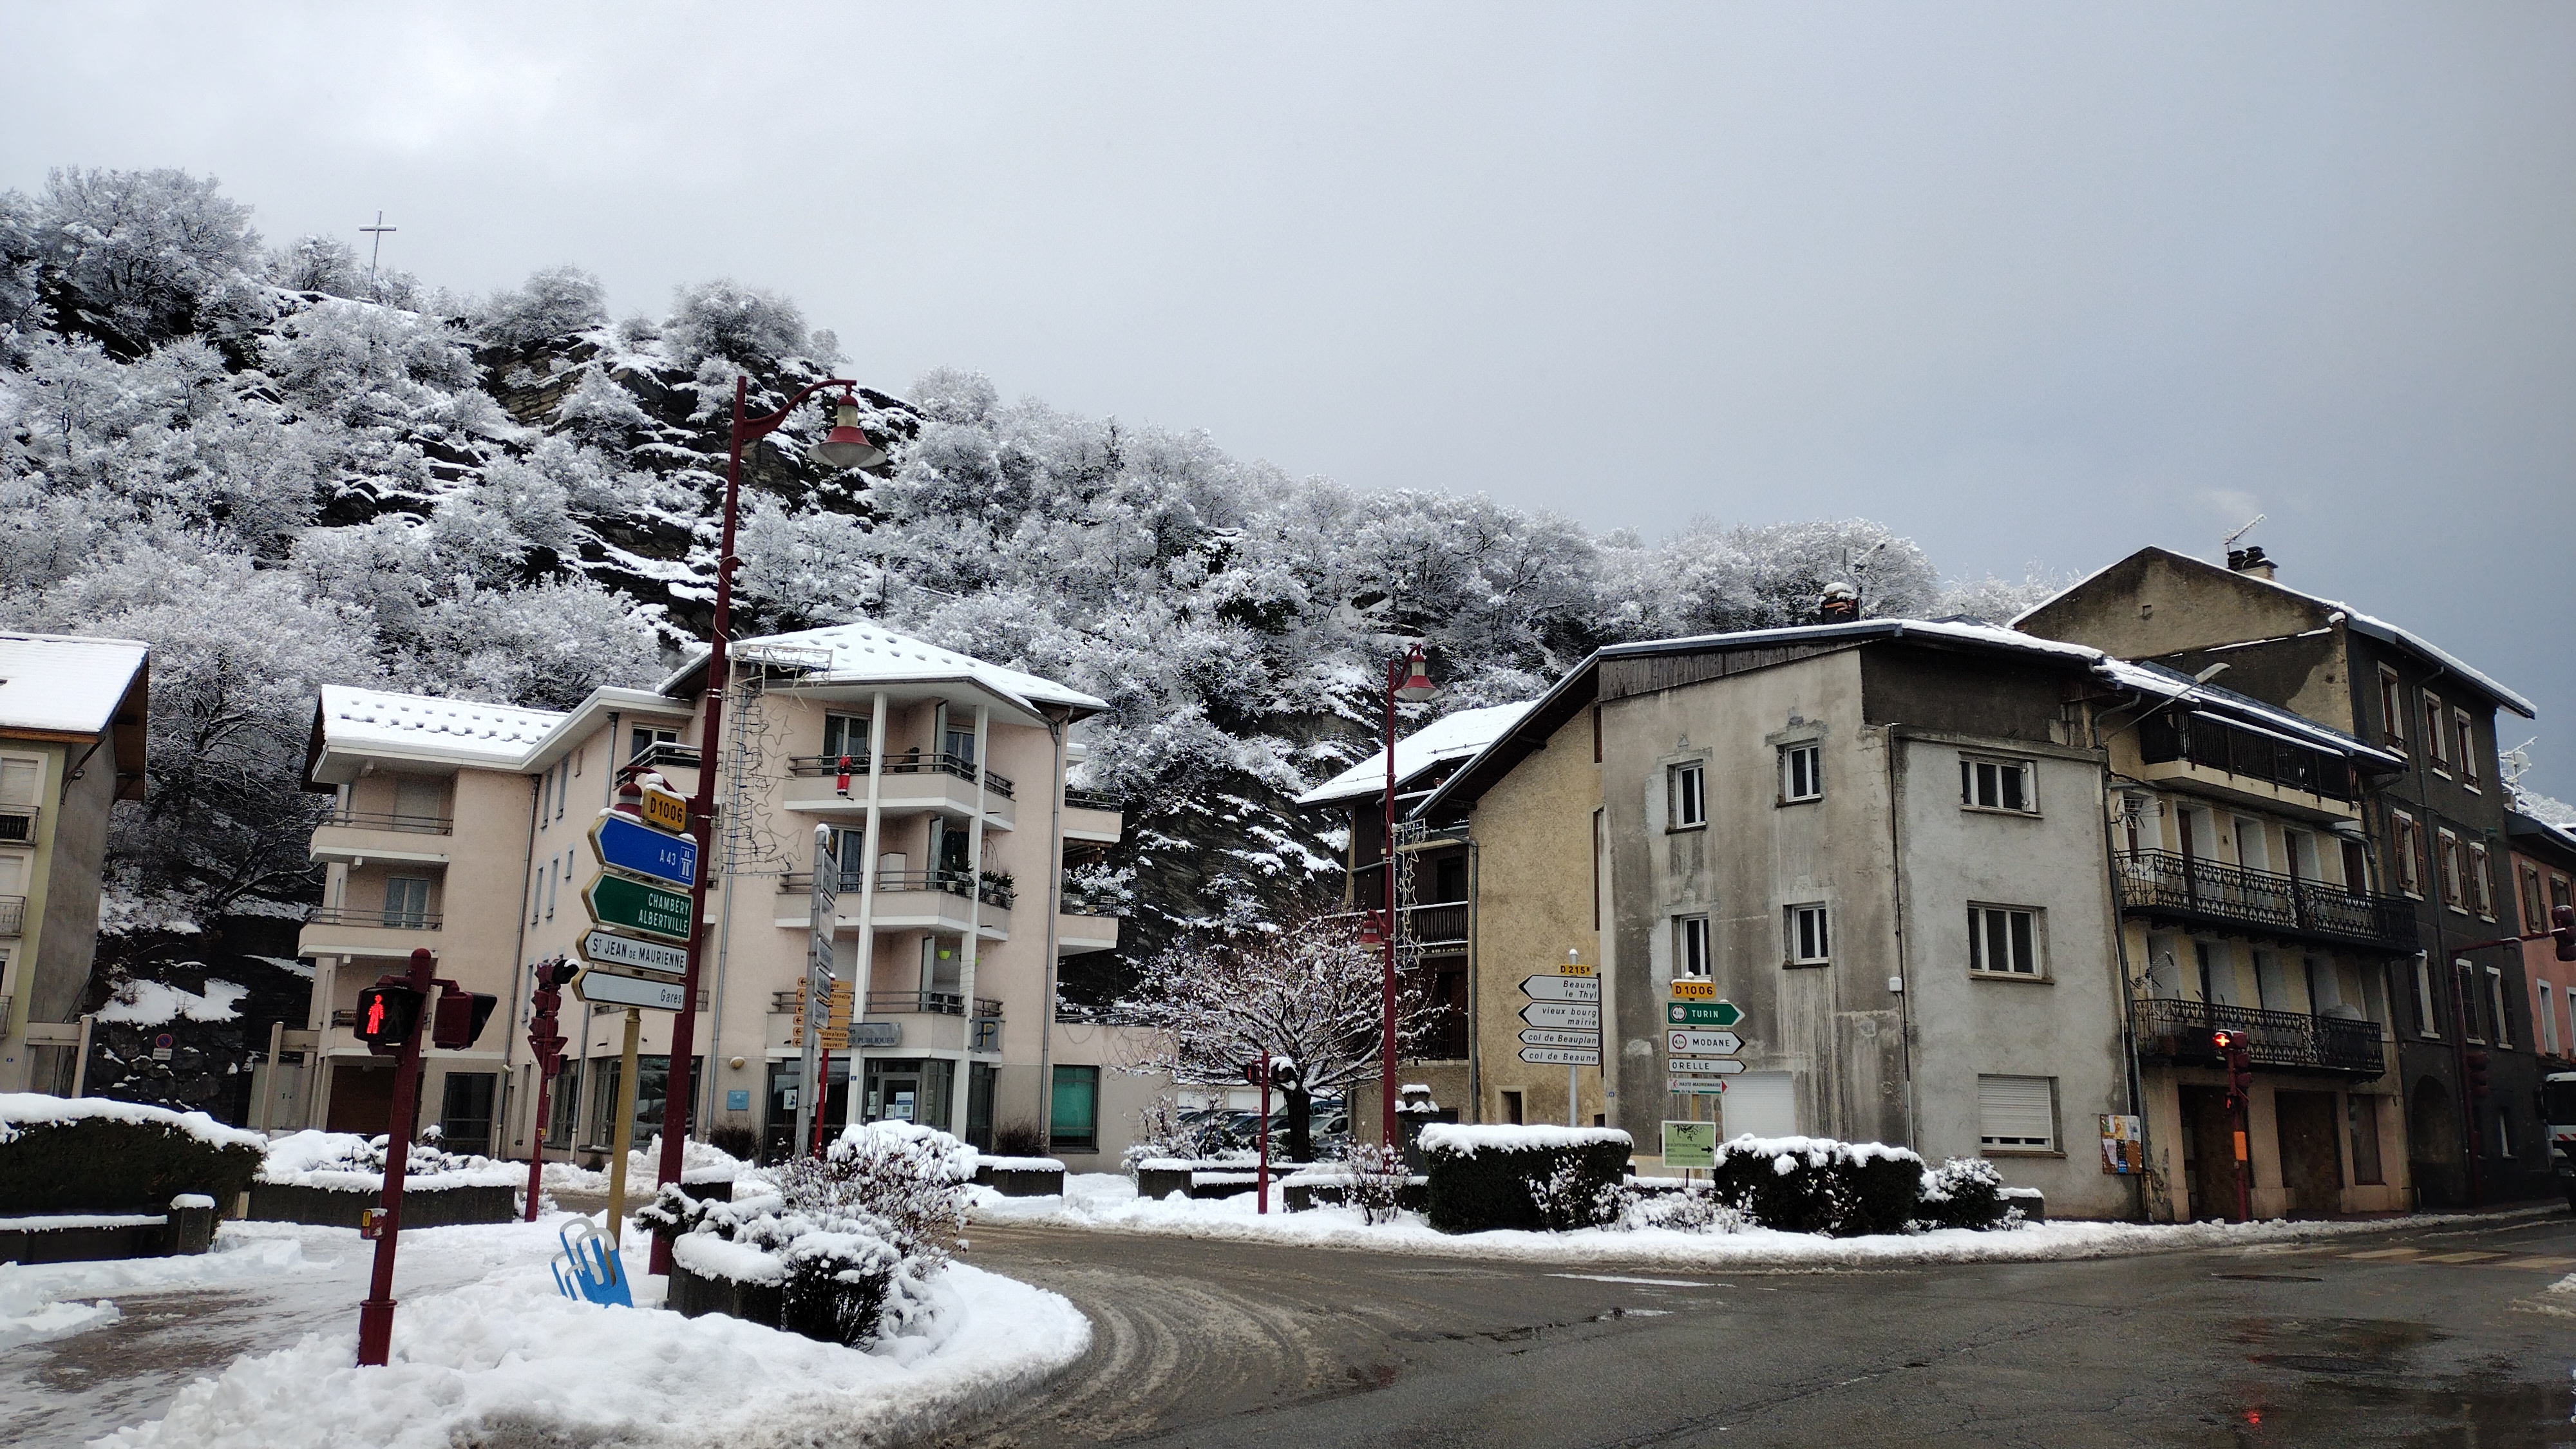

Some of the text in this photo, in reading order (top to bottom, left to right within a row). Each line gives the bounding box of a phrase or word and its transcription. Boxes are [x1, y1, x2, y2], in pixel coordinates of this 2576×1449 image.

[648, 893, 690, 916] CHAMBÉRY
[638, 909, 688, 933] ALBERTVILLE
[605, 940, 627, 958] JEAN
[638, 947, 685, 969] MAURIENNE
[1563, 980, 1596, 989] Beaune
[660, 989, 683, 1004] Gares
[1579, 990, 1597, 999] Thyl
[1542, 1007, 1596, 1018] vieux bourg
[1691, 1010, 1719, 1018] TURIN
[1567, 1018, 1596, 1027] mairie
[1558, 1034, 1596, 1045] Beauplan
[1692, 1039, 1730, 1047] MODANE
[1563, 1053, 1596, 1062] Beaune
[1672, 1062, 1710, 1070] ORELLE
